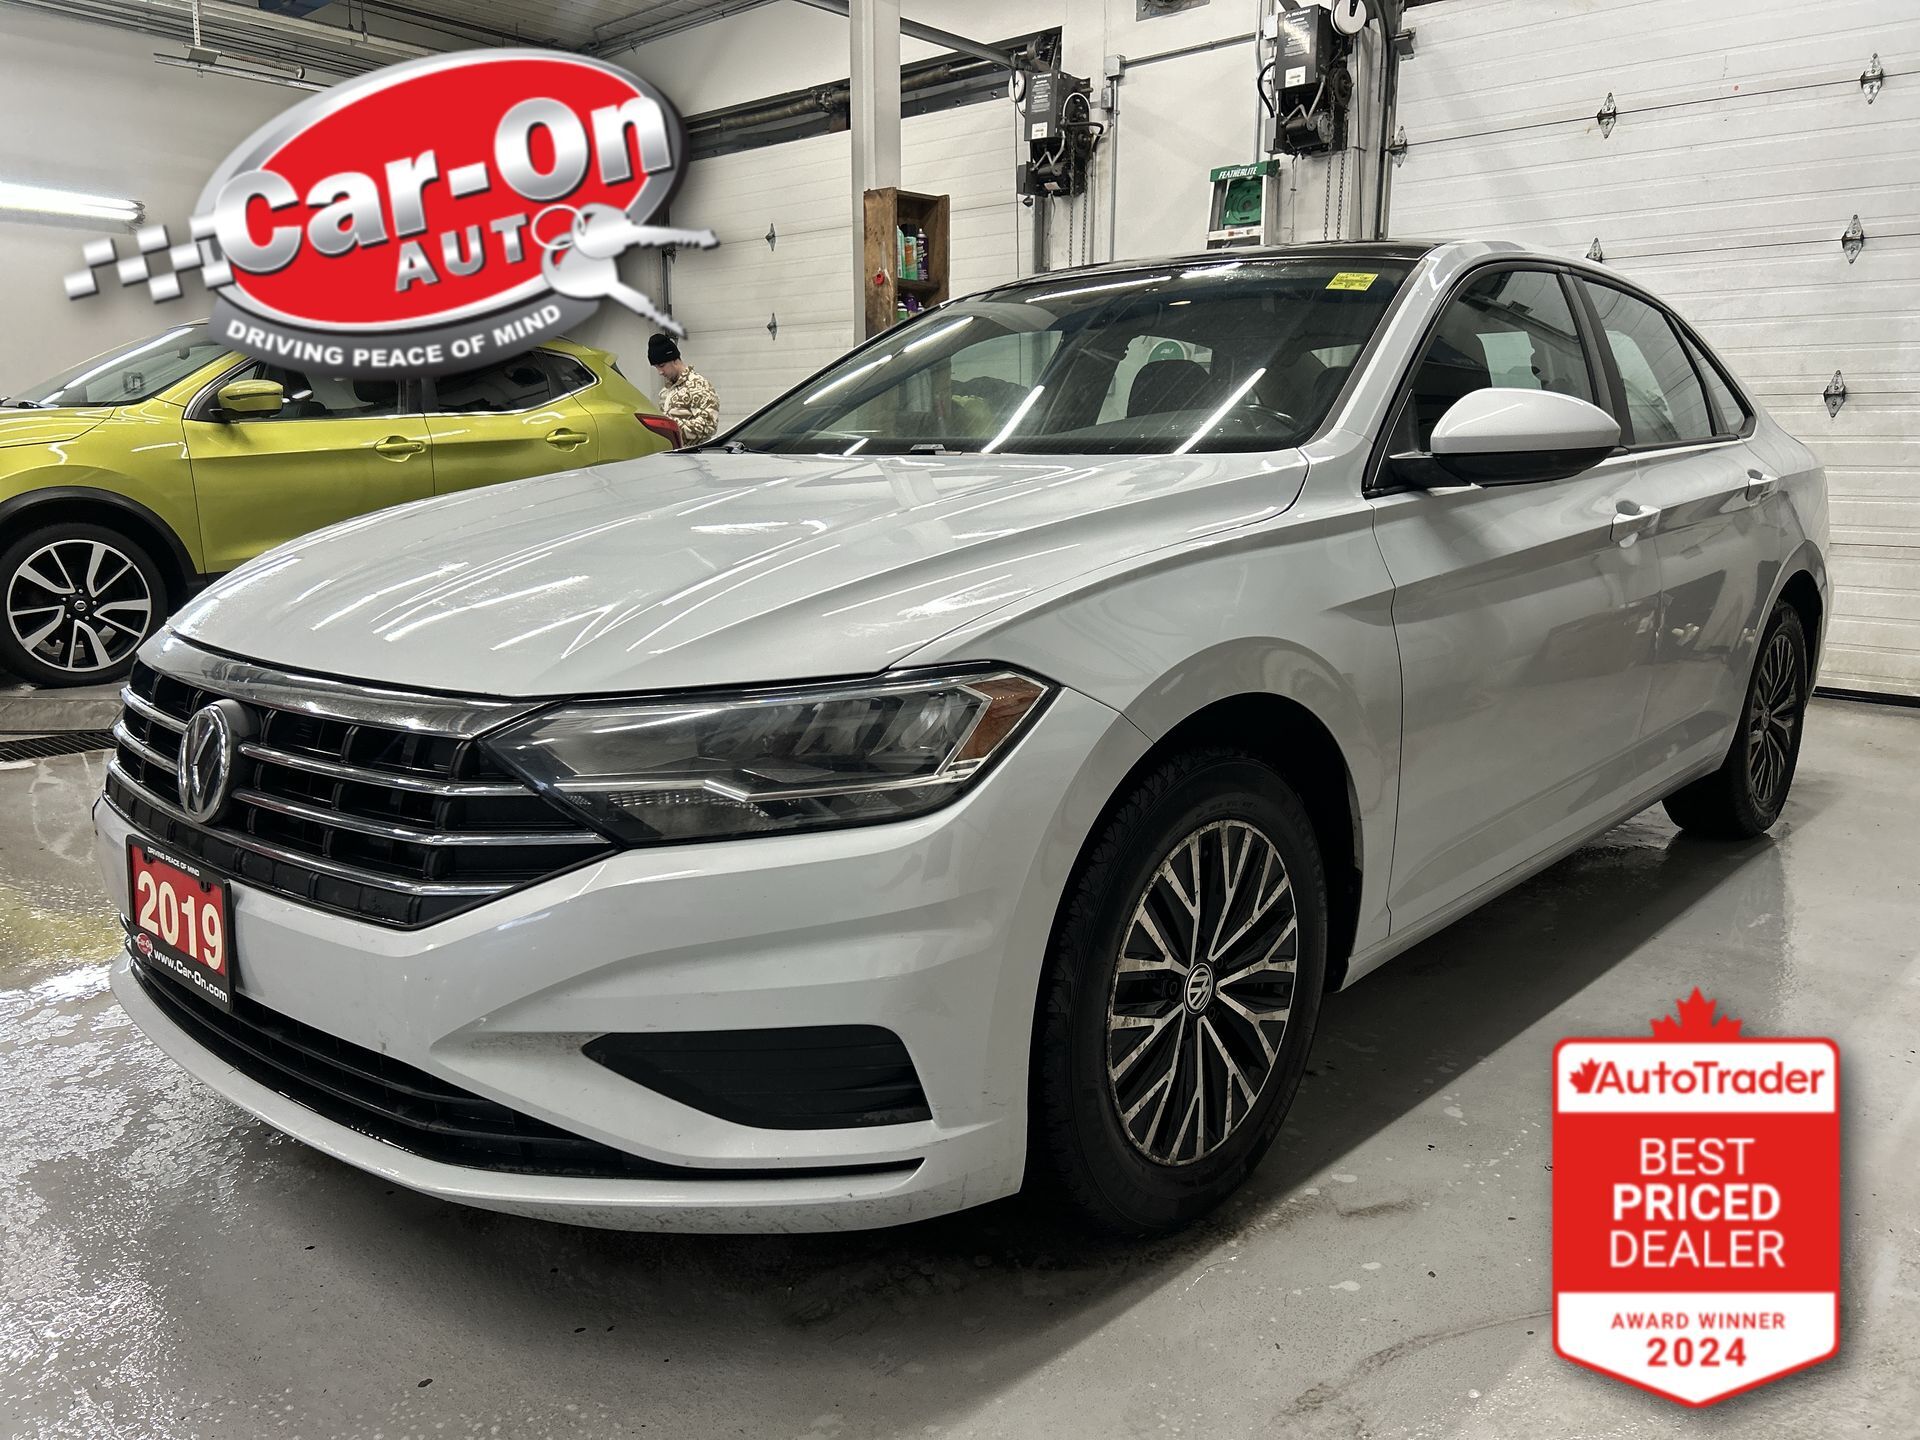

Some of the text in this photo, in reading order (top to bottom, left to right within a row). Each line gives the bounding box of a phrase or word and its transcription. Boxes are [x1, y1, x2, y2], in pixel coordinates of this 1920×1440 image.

[1218, 166, 1258, 180] FEATHERLITE
[137, 870, 223, 971] 2019
[153, 950, 228, 1003] www.Car-On.com
